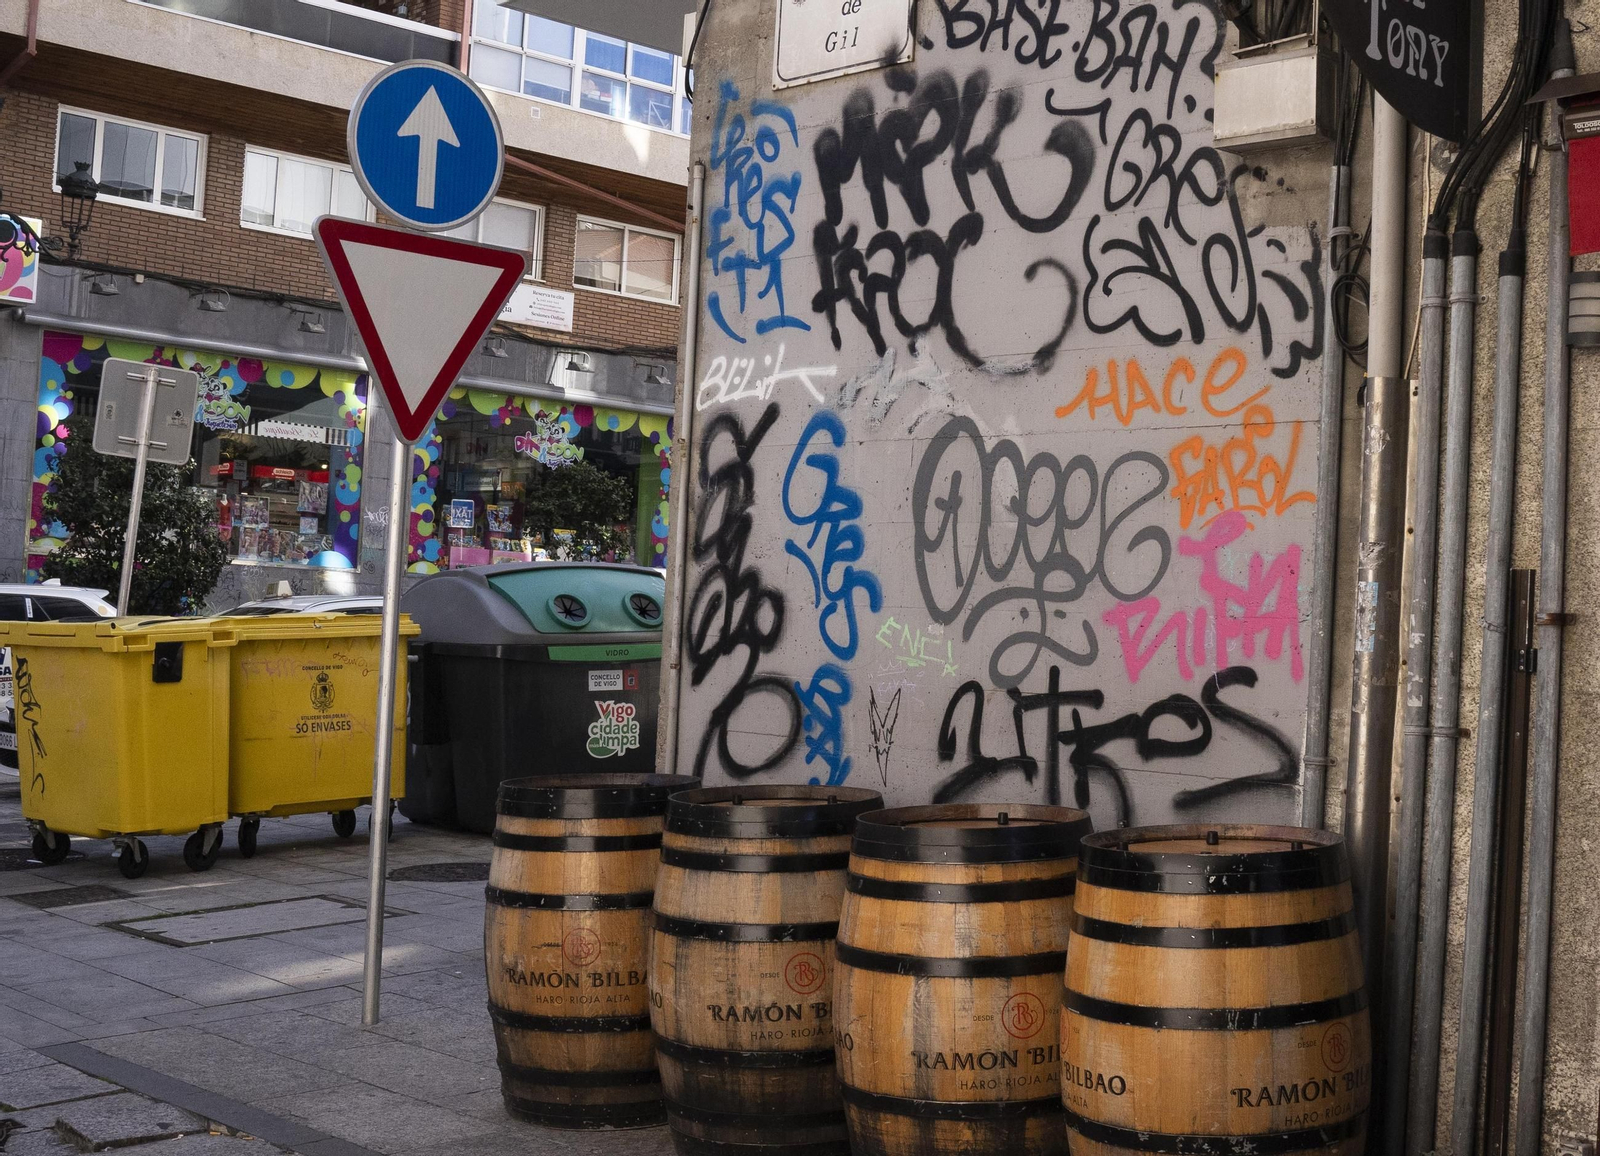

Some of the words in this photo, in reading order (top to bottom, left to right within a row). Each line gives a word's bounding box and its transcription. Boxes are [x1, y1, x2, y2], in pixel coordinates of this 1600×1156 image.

[842, 0, 861, 16] de
[825, 28, 859, 52] Gil
[599, 703, 634, 723] Vigo
[296, 721, 308, 734] SÓ
[311, 720, 351, 733] ENVASES
[591, 717, 637, 736] cidade
[506, 967, 580, 989] RAMÓN
[536, 995, 563, 1005] HARO
[570, 994, 600, 1005] RIOJA
[606, 993, 631, 1004] ALTA
[707, 1002, 803, 1024] RAMÓN
[750, 1030, 783, 1040] HARO
[791, 1026, 824, 1038] RIOJA
[1298, 1039, 1317, 1049] DESDE
[911, 1049, 1018, 1070] RAMÓN
[960, 1079, 996, 1090] HARO
[1006, 1076, 1042, 1087] RIOJA
[1063, 1061, 1126, 1096] BILBAO
[1073, 1095, 1088, 1109] ALTA
[1230, 1077, 1338, 1108] RAMÓN
[1285, 1111, 1319, 1127] HARO
[1326, 1103, 1352, 1120] RIOJA
